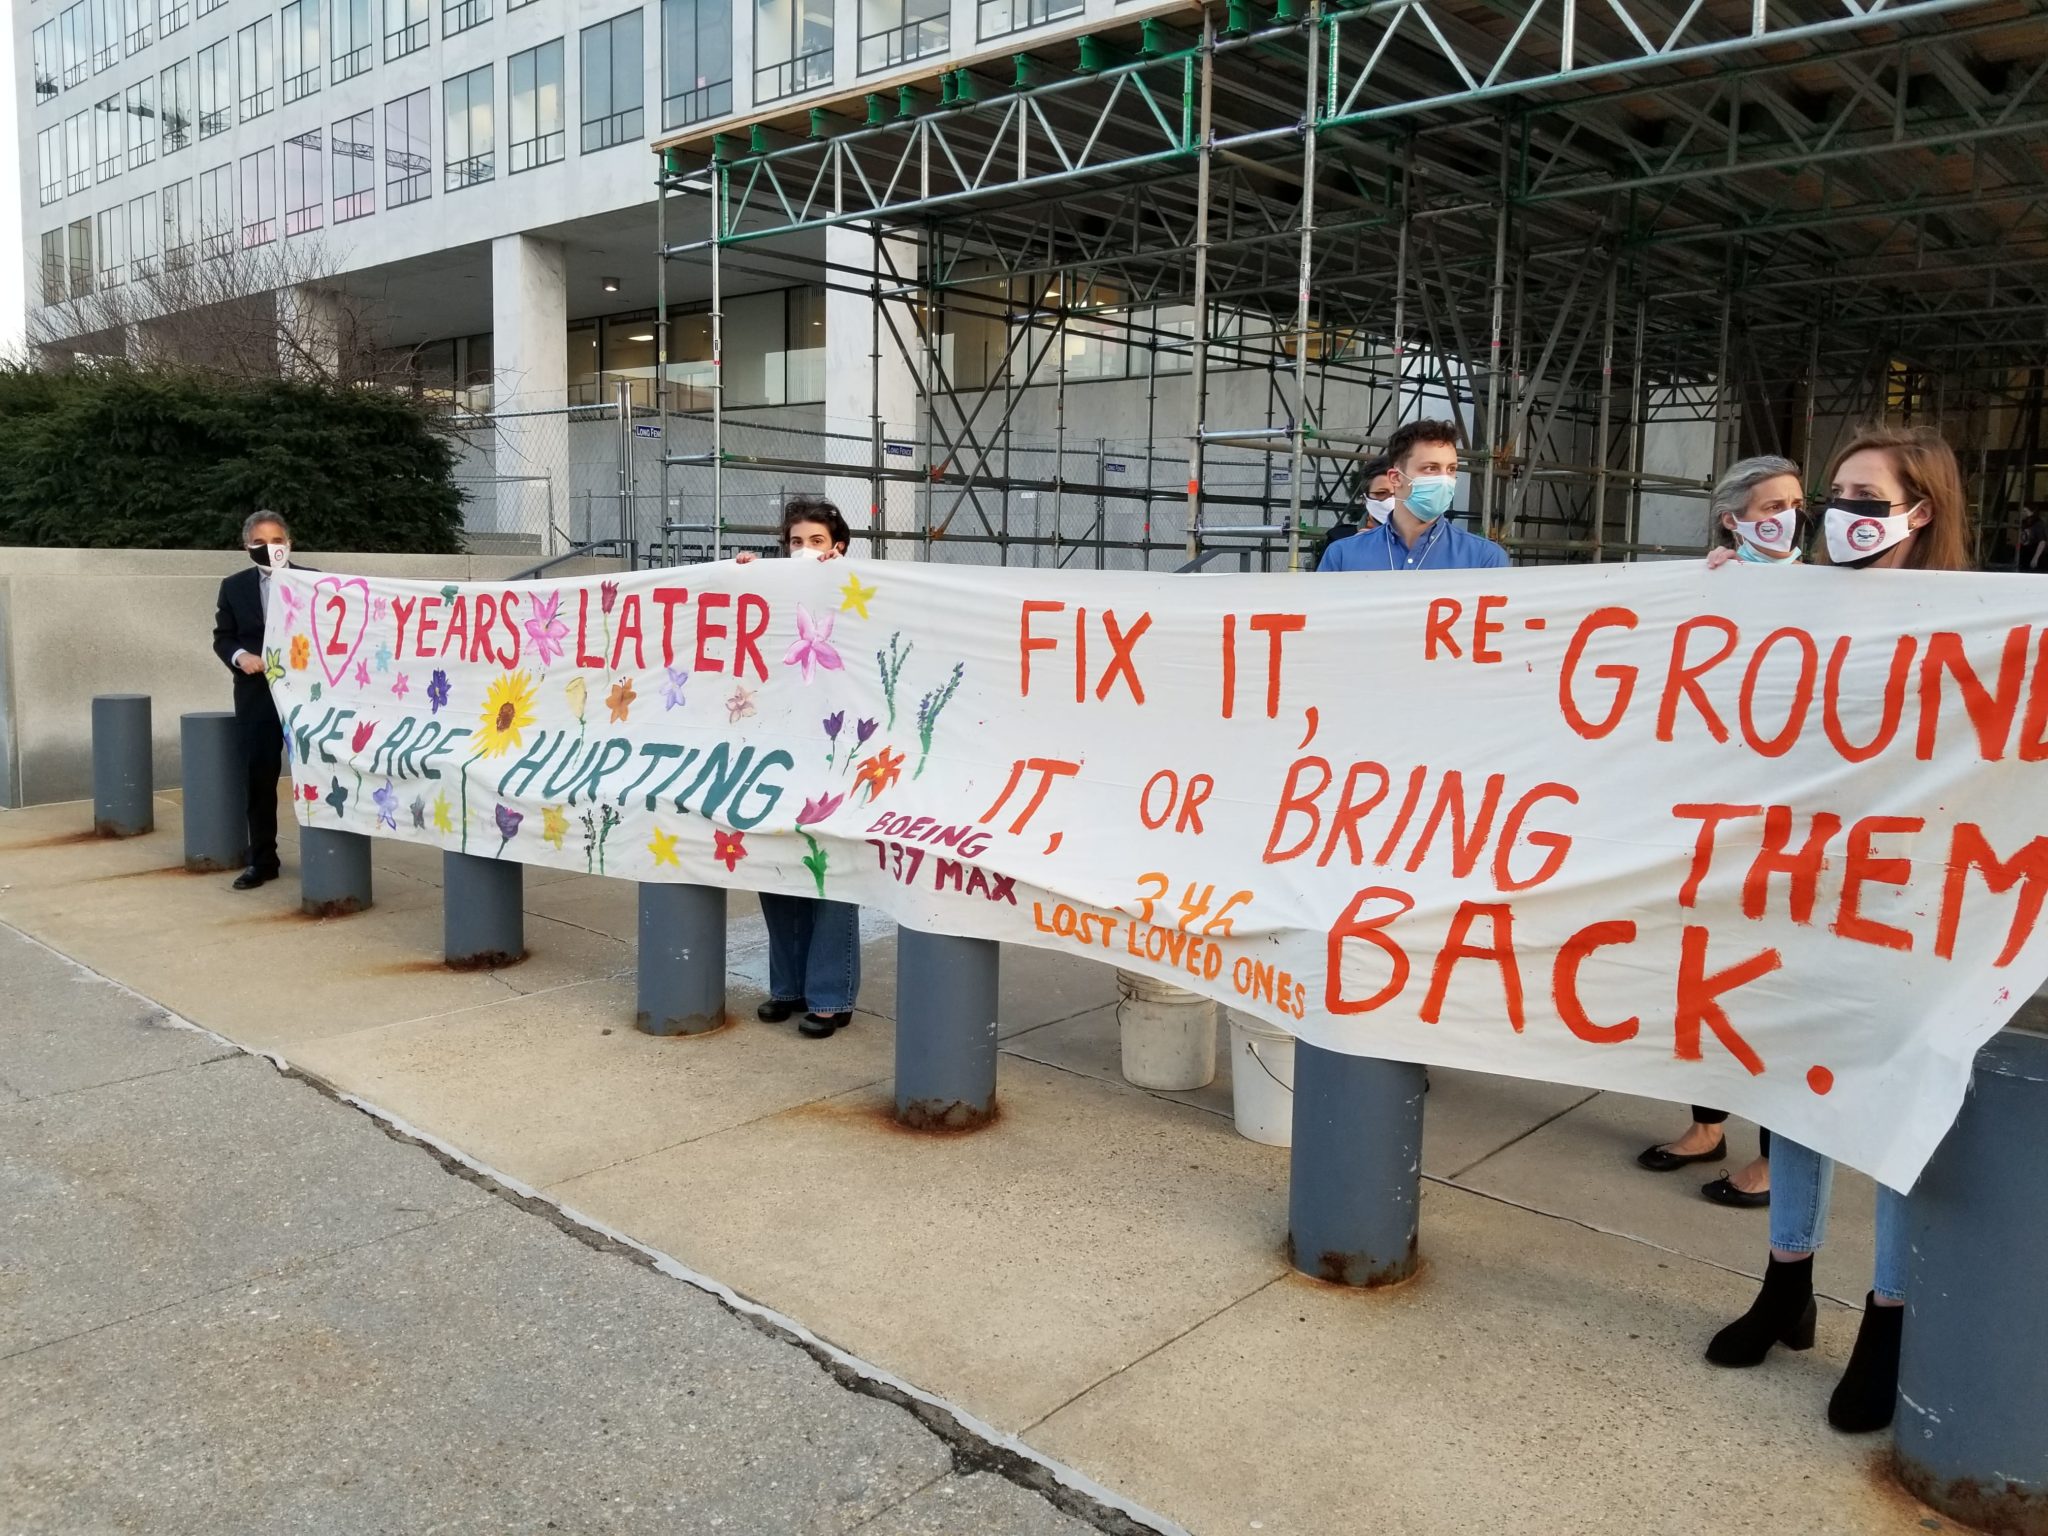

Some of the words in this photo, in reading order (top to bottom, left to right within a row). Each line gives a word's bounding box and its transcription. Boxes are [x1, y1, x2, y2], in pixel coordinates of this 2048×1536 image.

[325, 595, 346, 656] 2
[391, 589, 520, 670] YEARS
[575, 586, 769, 683] LATER
[1020, 600, 1153, 705] FIX
[1222, 613, 1319, 750] IT,
[288, 704, 357, 765] WE
[369, 716, 473, 781] ARE
[497, 729, 795, 830] HURTING
[865, 839, 925, 885] 737
[934, 857, 1018, 906] MAX
[866, 811, 993, 859] BOEING
[978, 758, 1081, 856] IT,
[1139, 769, 1215, 835] OR
[1262, 754, 1580, 893] BRING
[1672, 803, 2048, 968] THEM
[1033, 902, 1118, 948] LOST
[1127, 921, 1223, 980] LOVED
[1233, 956, 1306, 1020] ONES
[1134, 872, 1254, 937] 346
[1326, 885, 1836, 1096] BACK.
